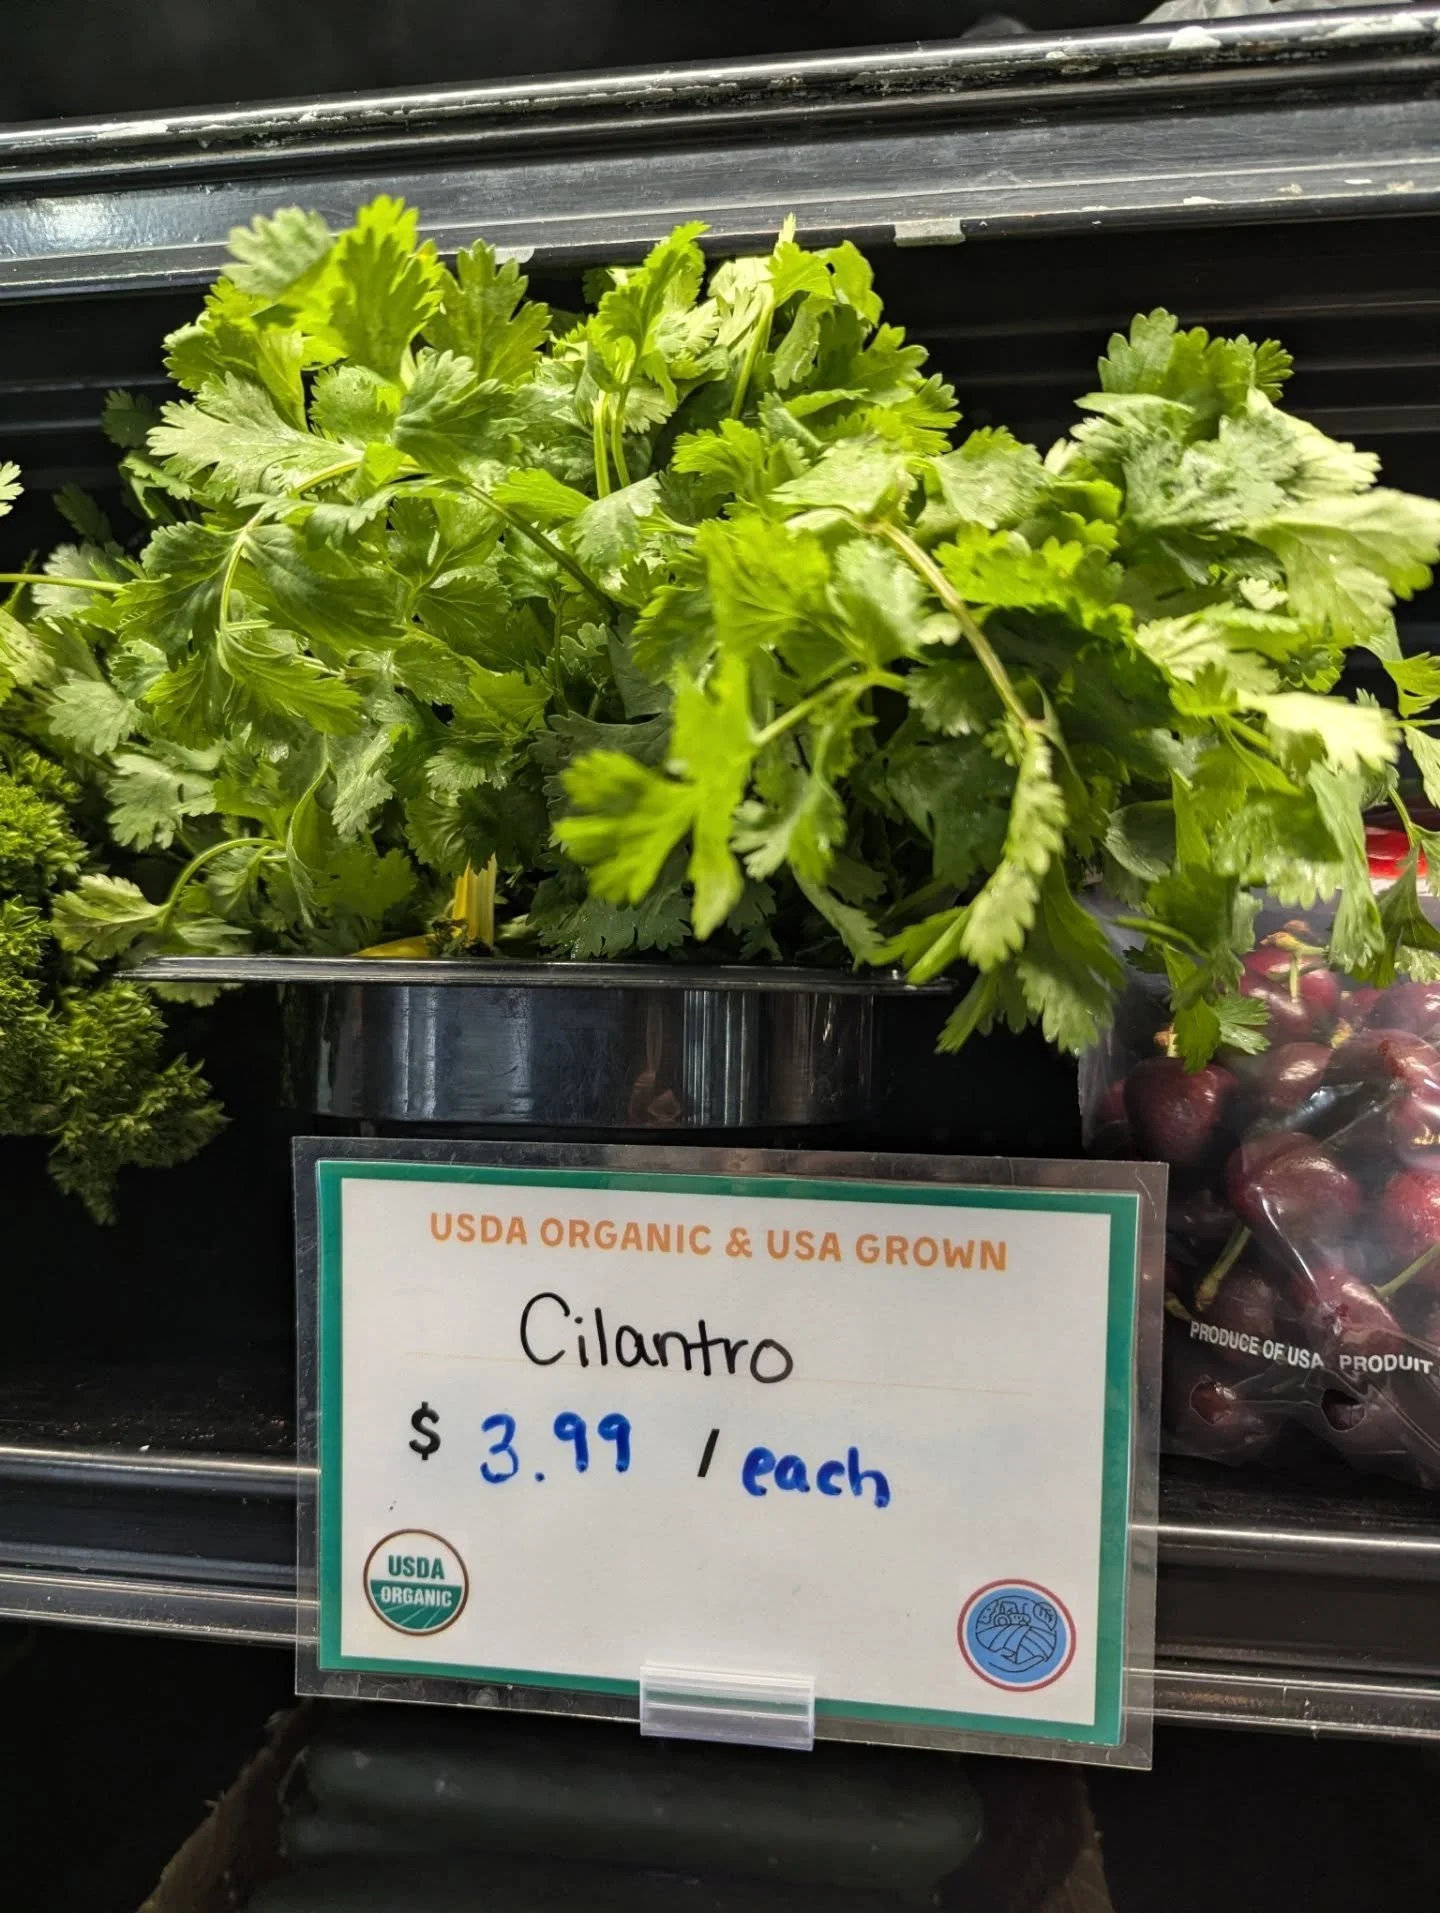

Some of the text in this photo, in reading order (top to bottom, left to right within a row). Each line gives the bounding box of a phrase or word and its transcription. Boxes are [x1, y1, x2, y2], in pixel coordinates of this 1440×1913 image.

[431, 1213, 1007, 1272] USDA ORGANIC & USA GROWN
[519, 1292, 794, 1384] Cilantro
[1190, 1321, 1434, 1374] PRODUCE OF USA PRODUIT
[408, 1401, 441, 1461] $
[480, 1412, 631, 1484] 3.99
[742, 1446, 891, 1508] each
[388, 1554, 445, 1580] USDA
[380, 1586, 453, 1608] ORGANIC
